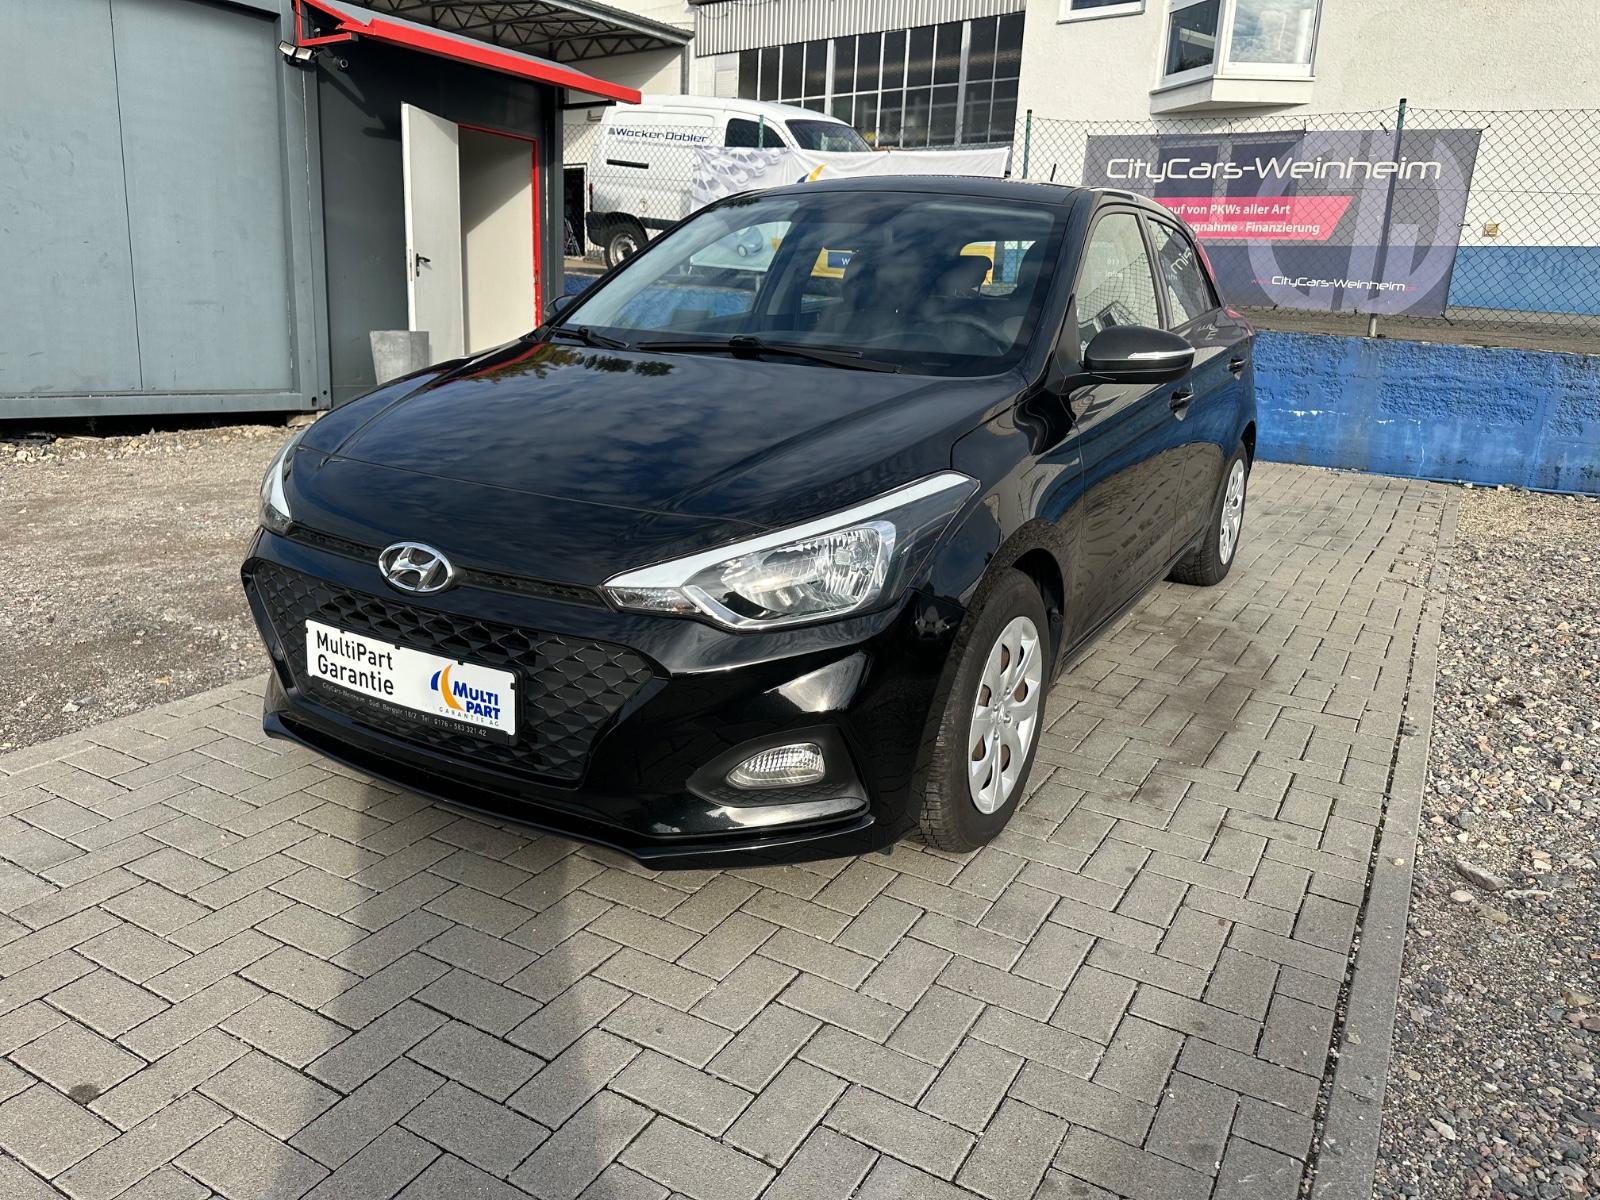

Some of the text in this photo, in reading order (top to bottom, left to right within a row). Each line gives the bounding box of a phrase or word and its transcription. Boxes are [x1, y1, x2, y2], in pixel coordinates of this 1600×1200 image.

[1106, 157, 1442, 183] CityCars-Weinheim
[1187, 206, 1207, 215] von
[1210, 204, 1241, 215] PKWs
[1243, 203, 1267, 215] aller
[1271, 204, 1291, 215] Art
[1245, 222, 1320, 236] Finanzierung
[317, 630, 393, 670] MultiPart
[318, 653, 394, 695] Garantie
[453, 680, 499, 706] MULTI
[439, 706, 484, 723] GARANTIE
[466, 700, 501, 720] PART
